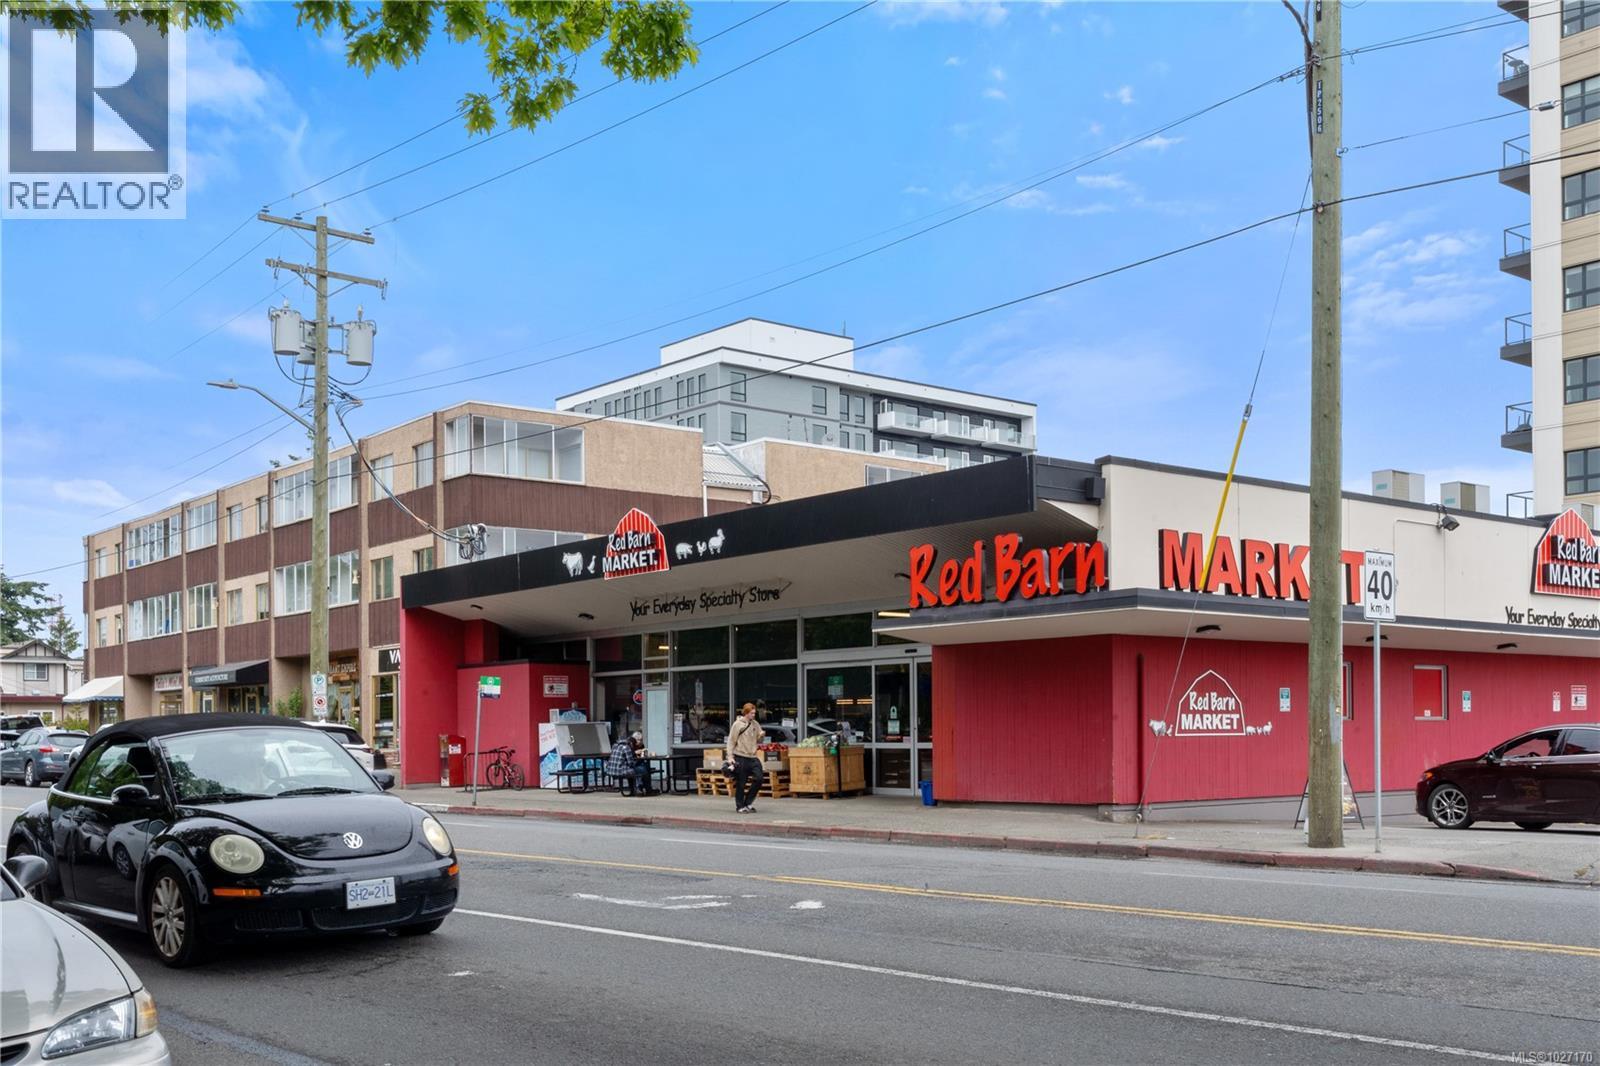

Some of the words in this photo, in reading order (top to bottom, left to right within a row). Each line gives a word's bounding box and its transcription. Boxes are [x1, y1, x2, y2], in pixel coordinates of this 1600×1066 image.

[608, 533, 626, 551] Red
[627, 530, 651, 550] Barn
[1557, 534, 1578, 560] Red
[1579, 536, 1600, 564] Bar
[909, 543, 985, 609] Red
[994, 532, 1106, 603] Barn
[1158, 528, 1365, 605] MARKT
[1549, 563, 1600, 589] MARKE
[1367, 570, 1393, 601] 40
[629, 600, 650, 621] Your
[653, 595, 697, 616] Everyday
[699, 589, 746, 612] Specialty
[750, 586, 780, 603] Store
[1505, 605, 1525, 625] Your
[1527, 608, 1566, 628] Everyday
[1189, 691, 1209, 711] Red
[1210, 692, 1236, 711] Barn
[1181, 713, 1240, 730] MARKET
